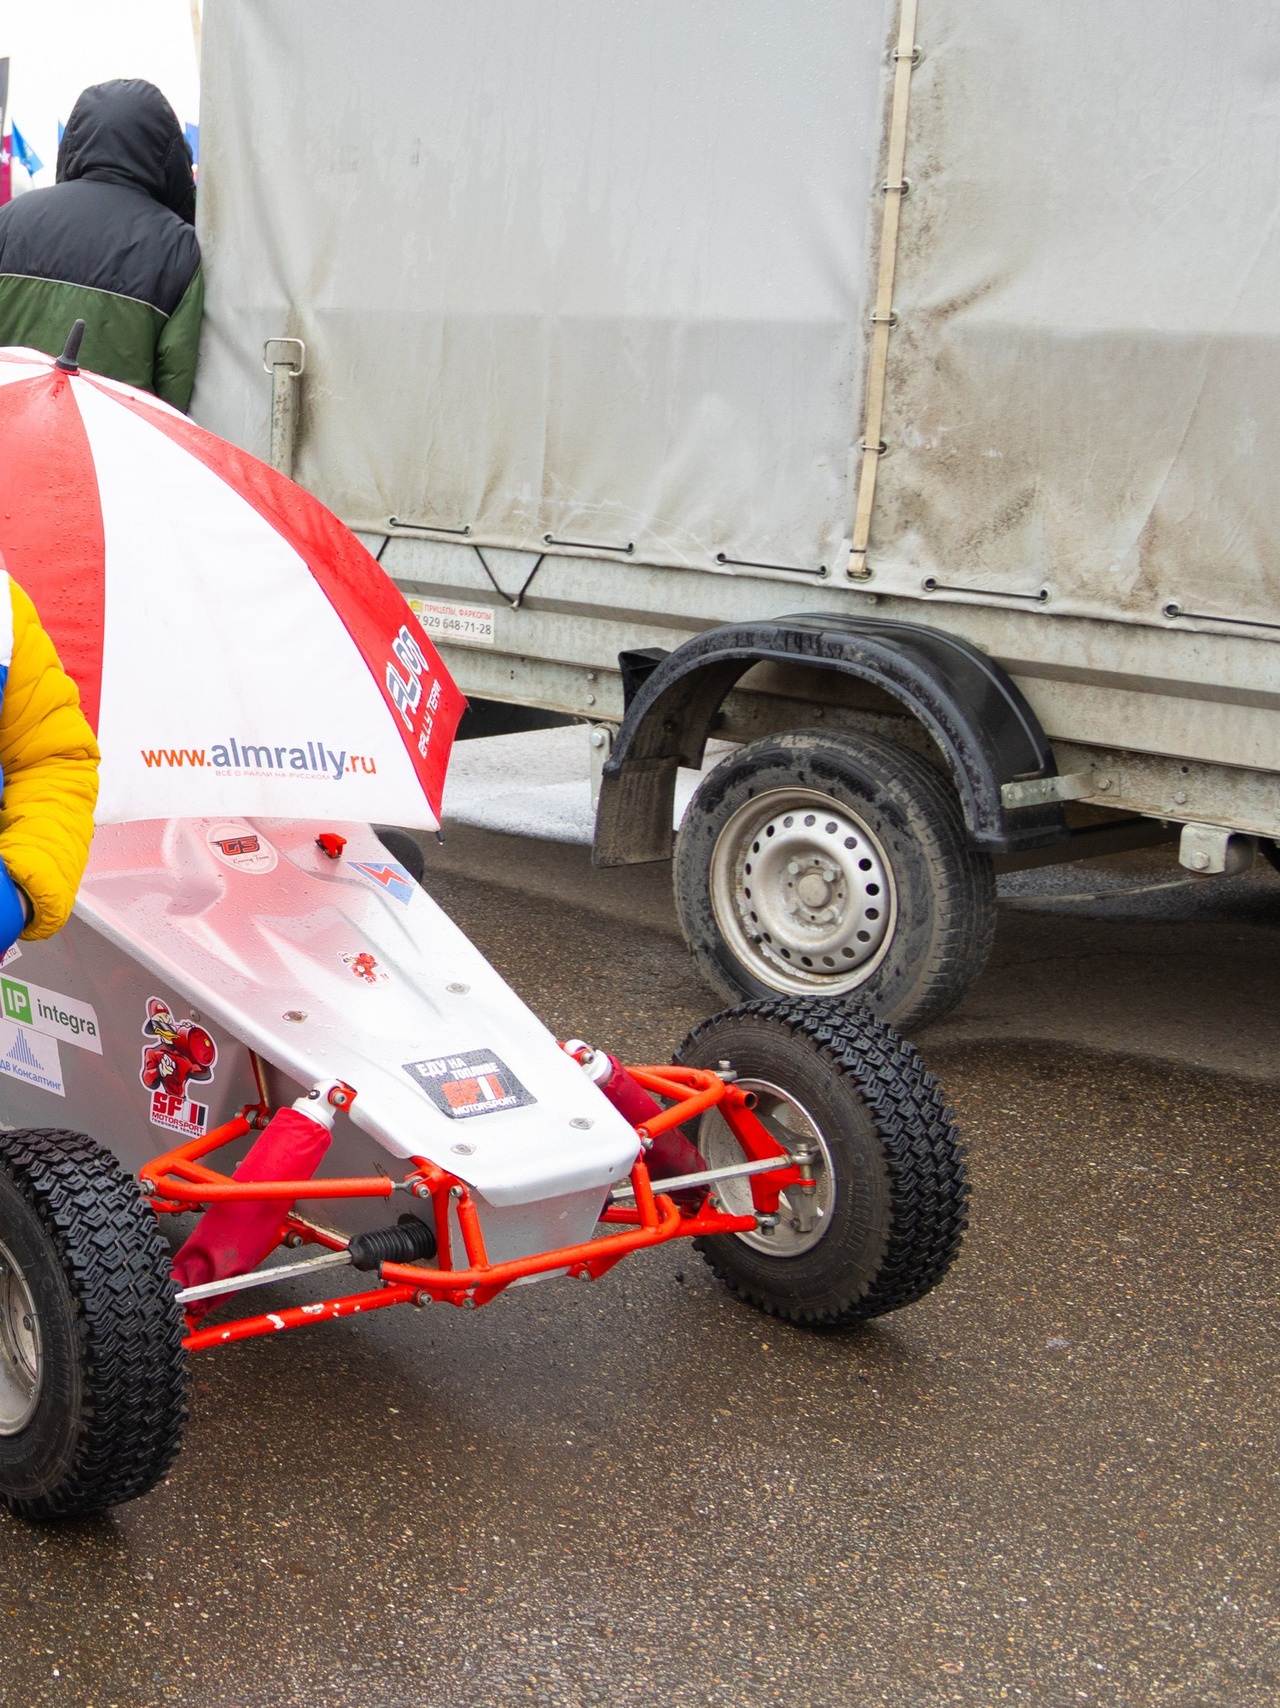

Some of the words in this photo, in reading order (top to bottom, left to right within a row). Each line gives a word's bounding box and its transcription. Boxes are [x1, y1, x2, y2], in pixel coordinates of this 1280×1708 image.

[458, 608, 492, 620] ФАРКОПЫ
[423, 616, 440, 627] 929
[442, 618, 492, 635] 648-71-28
[418, 711, 433, 759] RALLY
[426, 679, 442, 714] TEAM
[140, 738, 377, 780] www.almrally.ru
[6, 987, 28, 1014] IP
[37, 999, 98, 1037] integra
[12, 1063, 62, 1091] Консалтинг
[415, 1060, 447, 1078] ЕДУ
[447, 1057, 468, 1070] НА
[450, 1062, 501, 1080] ТОПЛИВЕ
[451, 1096, 519, 1115] MOTORSPORT
[152, 1111, 205, 1134] MOTORSPORT
